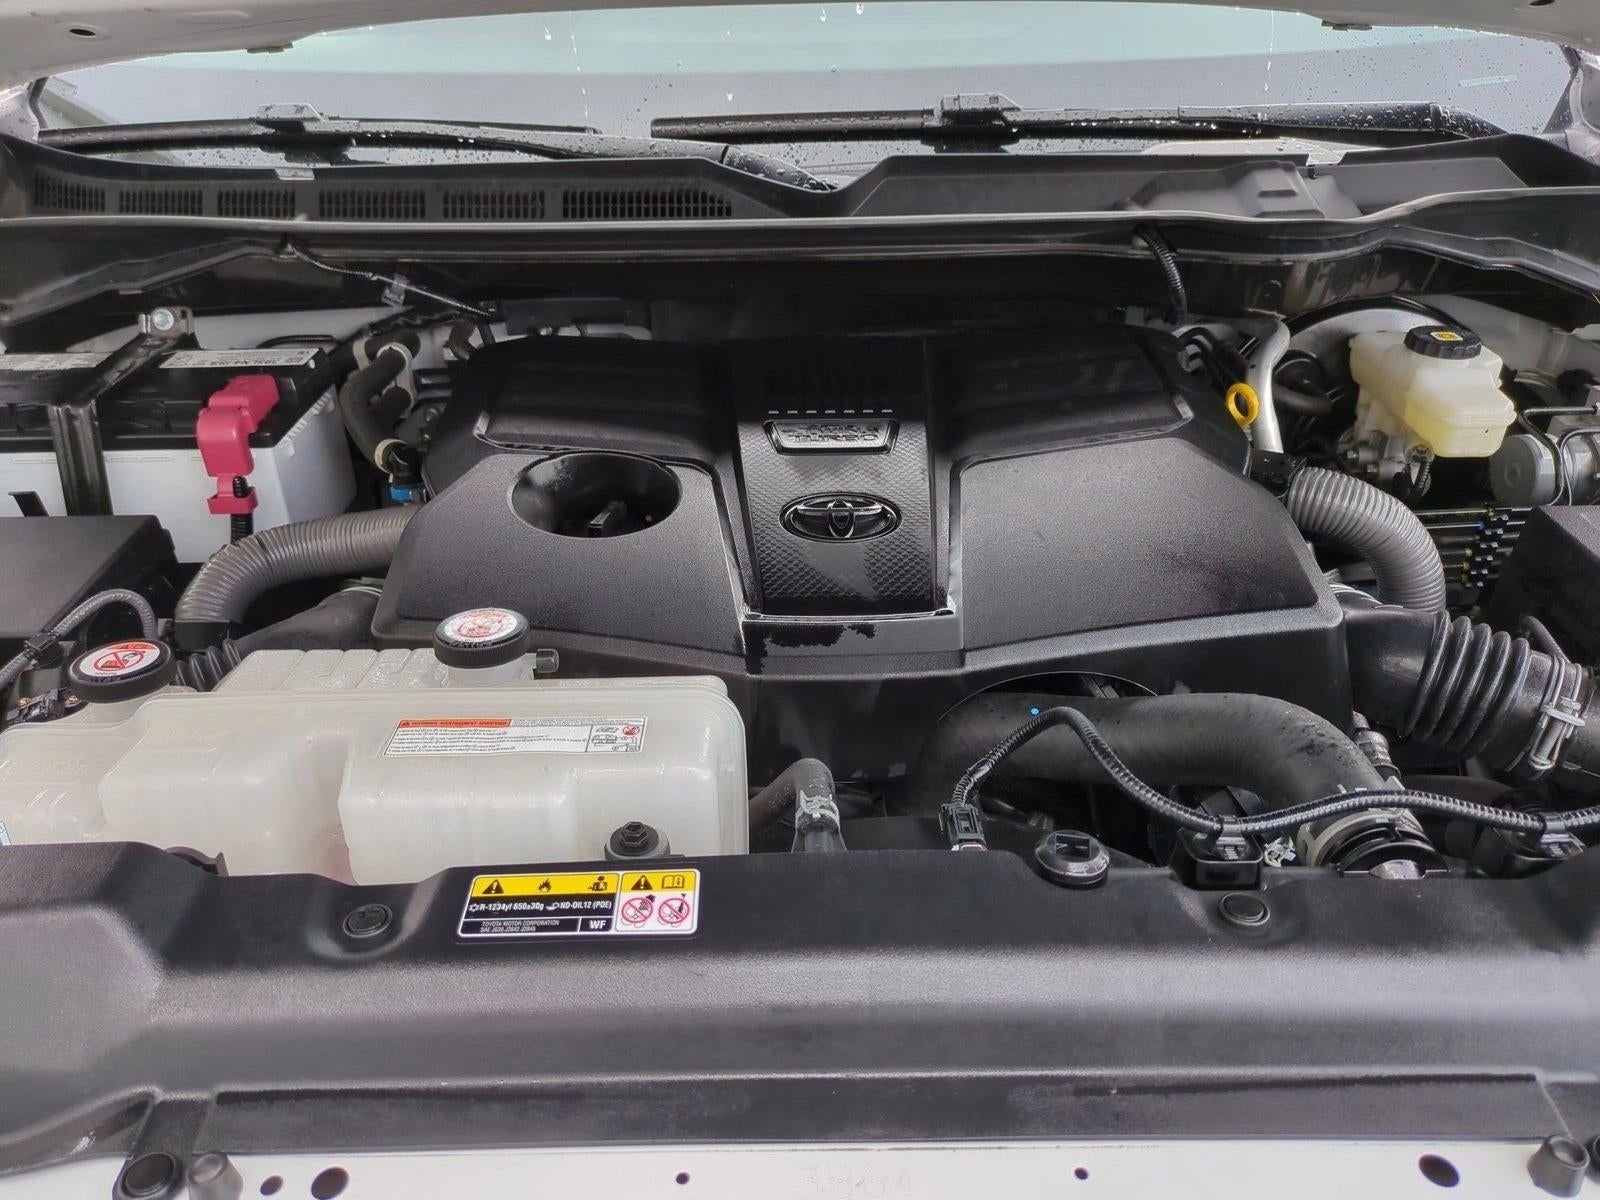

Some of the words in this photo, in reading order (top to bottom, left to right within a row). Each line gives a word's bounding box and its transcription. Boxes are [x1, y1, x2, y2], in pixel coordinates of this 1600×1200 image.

[479, 903, 512, 912] R-1234yf
[513, 902, 544, 911] 650±30g
[592, 900, 612, 910] (POE)
[589, 920, 607, 929] WF
